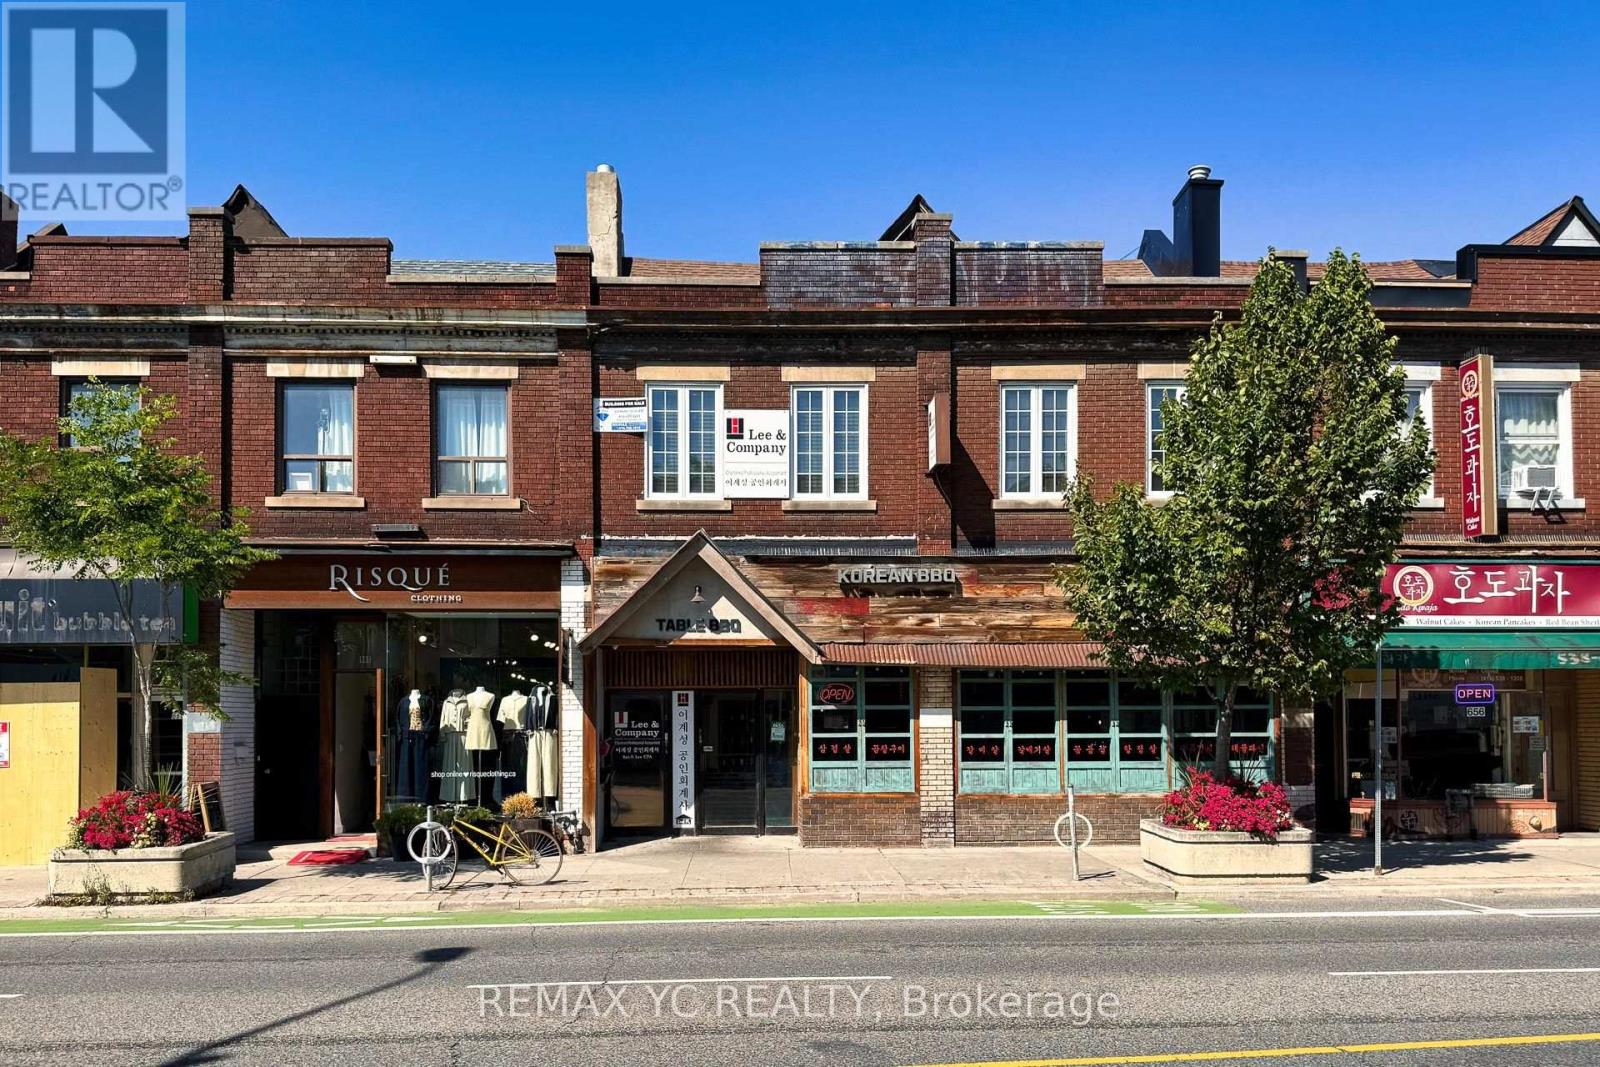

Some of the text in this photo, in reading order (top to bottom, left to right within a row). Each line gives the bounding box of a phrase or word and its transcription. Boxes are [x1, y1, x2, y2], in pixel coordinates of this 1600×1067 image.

[749, 429, 787, 440] Lee &
[726, 442, 787, 456] Company
[1461, 405, 1481, 512] 호도과자
[838, 568, 957, 583] KOREAN BBQ
[329, 563, 450, 602] RISQUÉ
[1443, 565, 1571, 614] 호도과자
[410, 594, 462, 604] CLOTHING
[1412, 603, 1438, 613] Kwaja
[656, 619, 742, 634] TABLE BBQ
[1503, 618, 1536, 626] Pancakes
[822, 687, 853, 701] OPEN
[1458, 689, 1491, 698] OPEN
[615, 729, 660, 738] Company
[431, 770, 516, 779] shop online risqueclothing.ca
